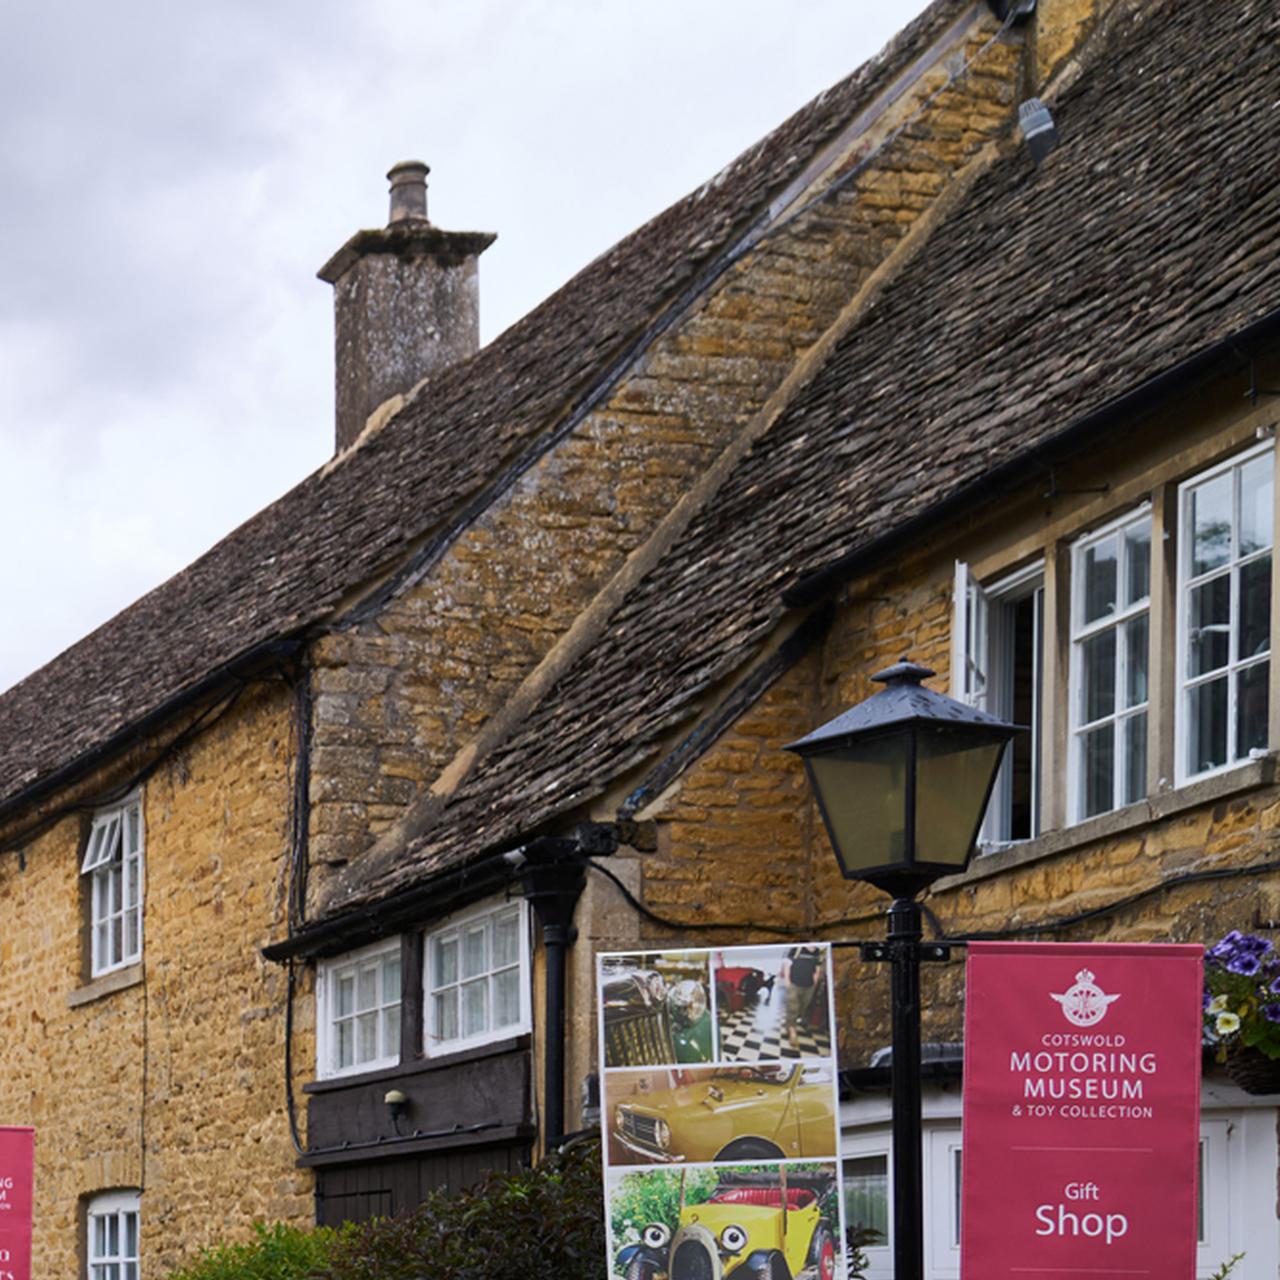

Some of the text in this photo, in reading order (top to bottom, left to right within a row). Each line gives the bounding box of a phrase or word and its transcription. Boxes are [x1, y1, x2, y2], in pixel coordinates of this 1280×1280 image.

[1041, 1034, 1126, 1048] COTSWOLD
[1010, 1051, 1157, 1074] MOTORING
[1023, 1077, 1143, 1100] MUSEUM
[1012, 1105, 1153, 1118] & TOY COLLECTION
[1064, 1181, 1100, 1201] Gift
[1035, 1204, 1129, 1245] Shop
